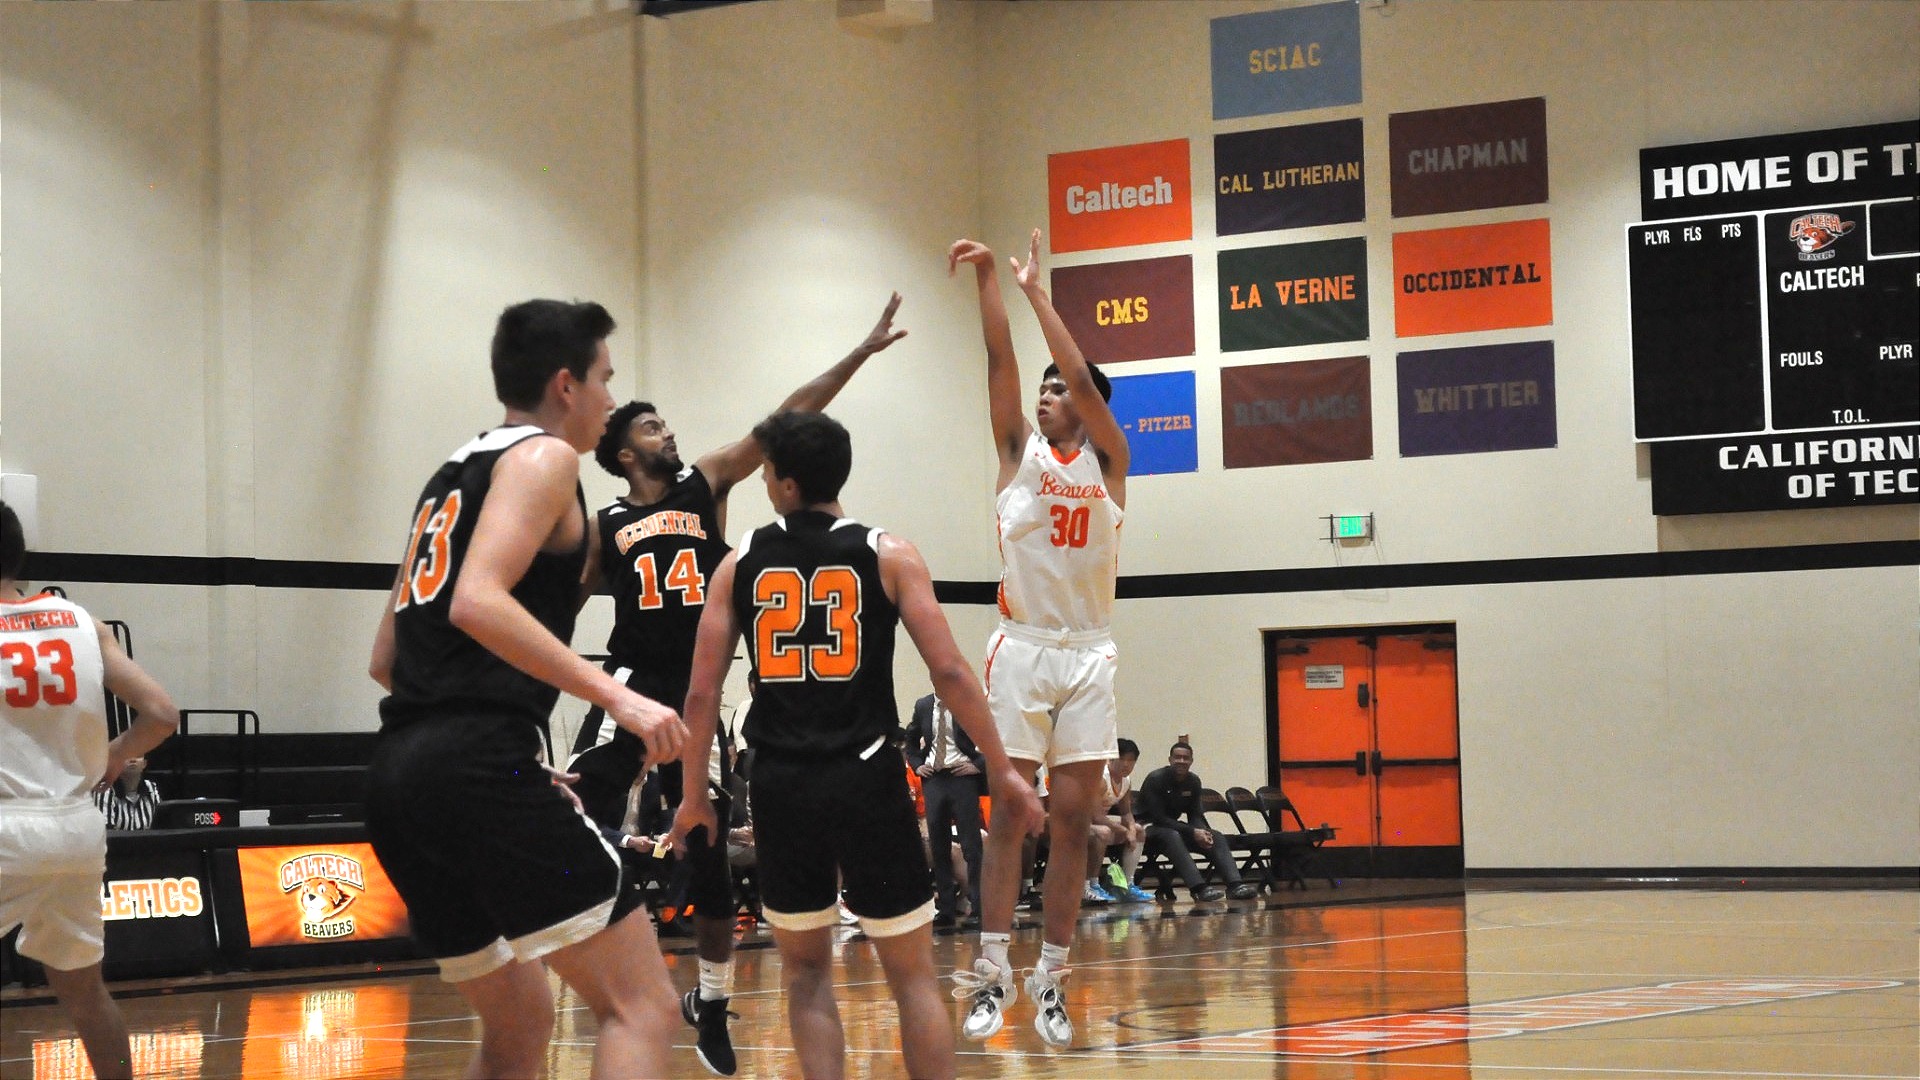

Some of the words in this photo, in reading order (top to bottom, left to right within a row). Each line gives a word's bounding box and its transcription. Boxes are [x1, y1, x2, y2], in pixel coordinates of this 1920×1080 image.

[1248, 43, 1322, 74] SCIAC
[1408, 138, 1528, 176] CHAPMAN
[1653, 155, 1792, 200] HOME
[1806, 148, 1868, 183] OF
[1882, 142, 1920, 176] T
[1219, 173, 1253, 195] CAL
[1263, 162, 1360, 190] LUTHERAN
[1066, 176, 1173, 215] Caltech
[1645, 229, 1670, 246] PLYR
[1683, 226, 1702, 242] FLS
[1721, 223, 1741, 239] PTS
[1790, 212, 1842, 237] CALTECH
[1230, 285, 1262, 310] LA
[1276, 274, 1355, 305] VERNE
[1403, 263, 1541, 294] OCCIDENTAL
[1780, 265, 1865, 293] CALTECH
[1096, 297, 1148, 326] CMS
[1780, 350, 1823, 368] FOULS
[1879, 344, 1913, 360] PLYR
[1414, 380, 1539, 414] WHITTIER
[1138, 415, 1192, 432] PITZER
[1832, 409, 1870, 425] T.O.L.
[1719, 435, 1920, 470] CALIFORN
[1036, 472, 1106, 498] Beavers
[1788, 473, 1836, 499] OF
[615, 510, 707, 555] OCCIDENTAL
[1050, 504, 1090, 548] 30
[394, 489, 461, 612] 13
[634, 548, 705, 610] 14
[753, 565, 862, 683] 23
[0, 639, 77, 708] 33
[194, 813, 215, 825] POSS
[281, 854, 363, 890] CALTECH
[304, 920, 353, 937] BEAVERS
